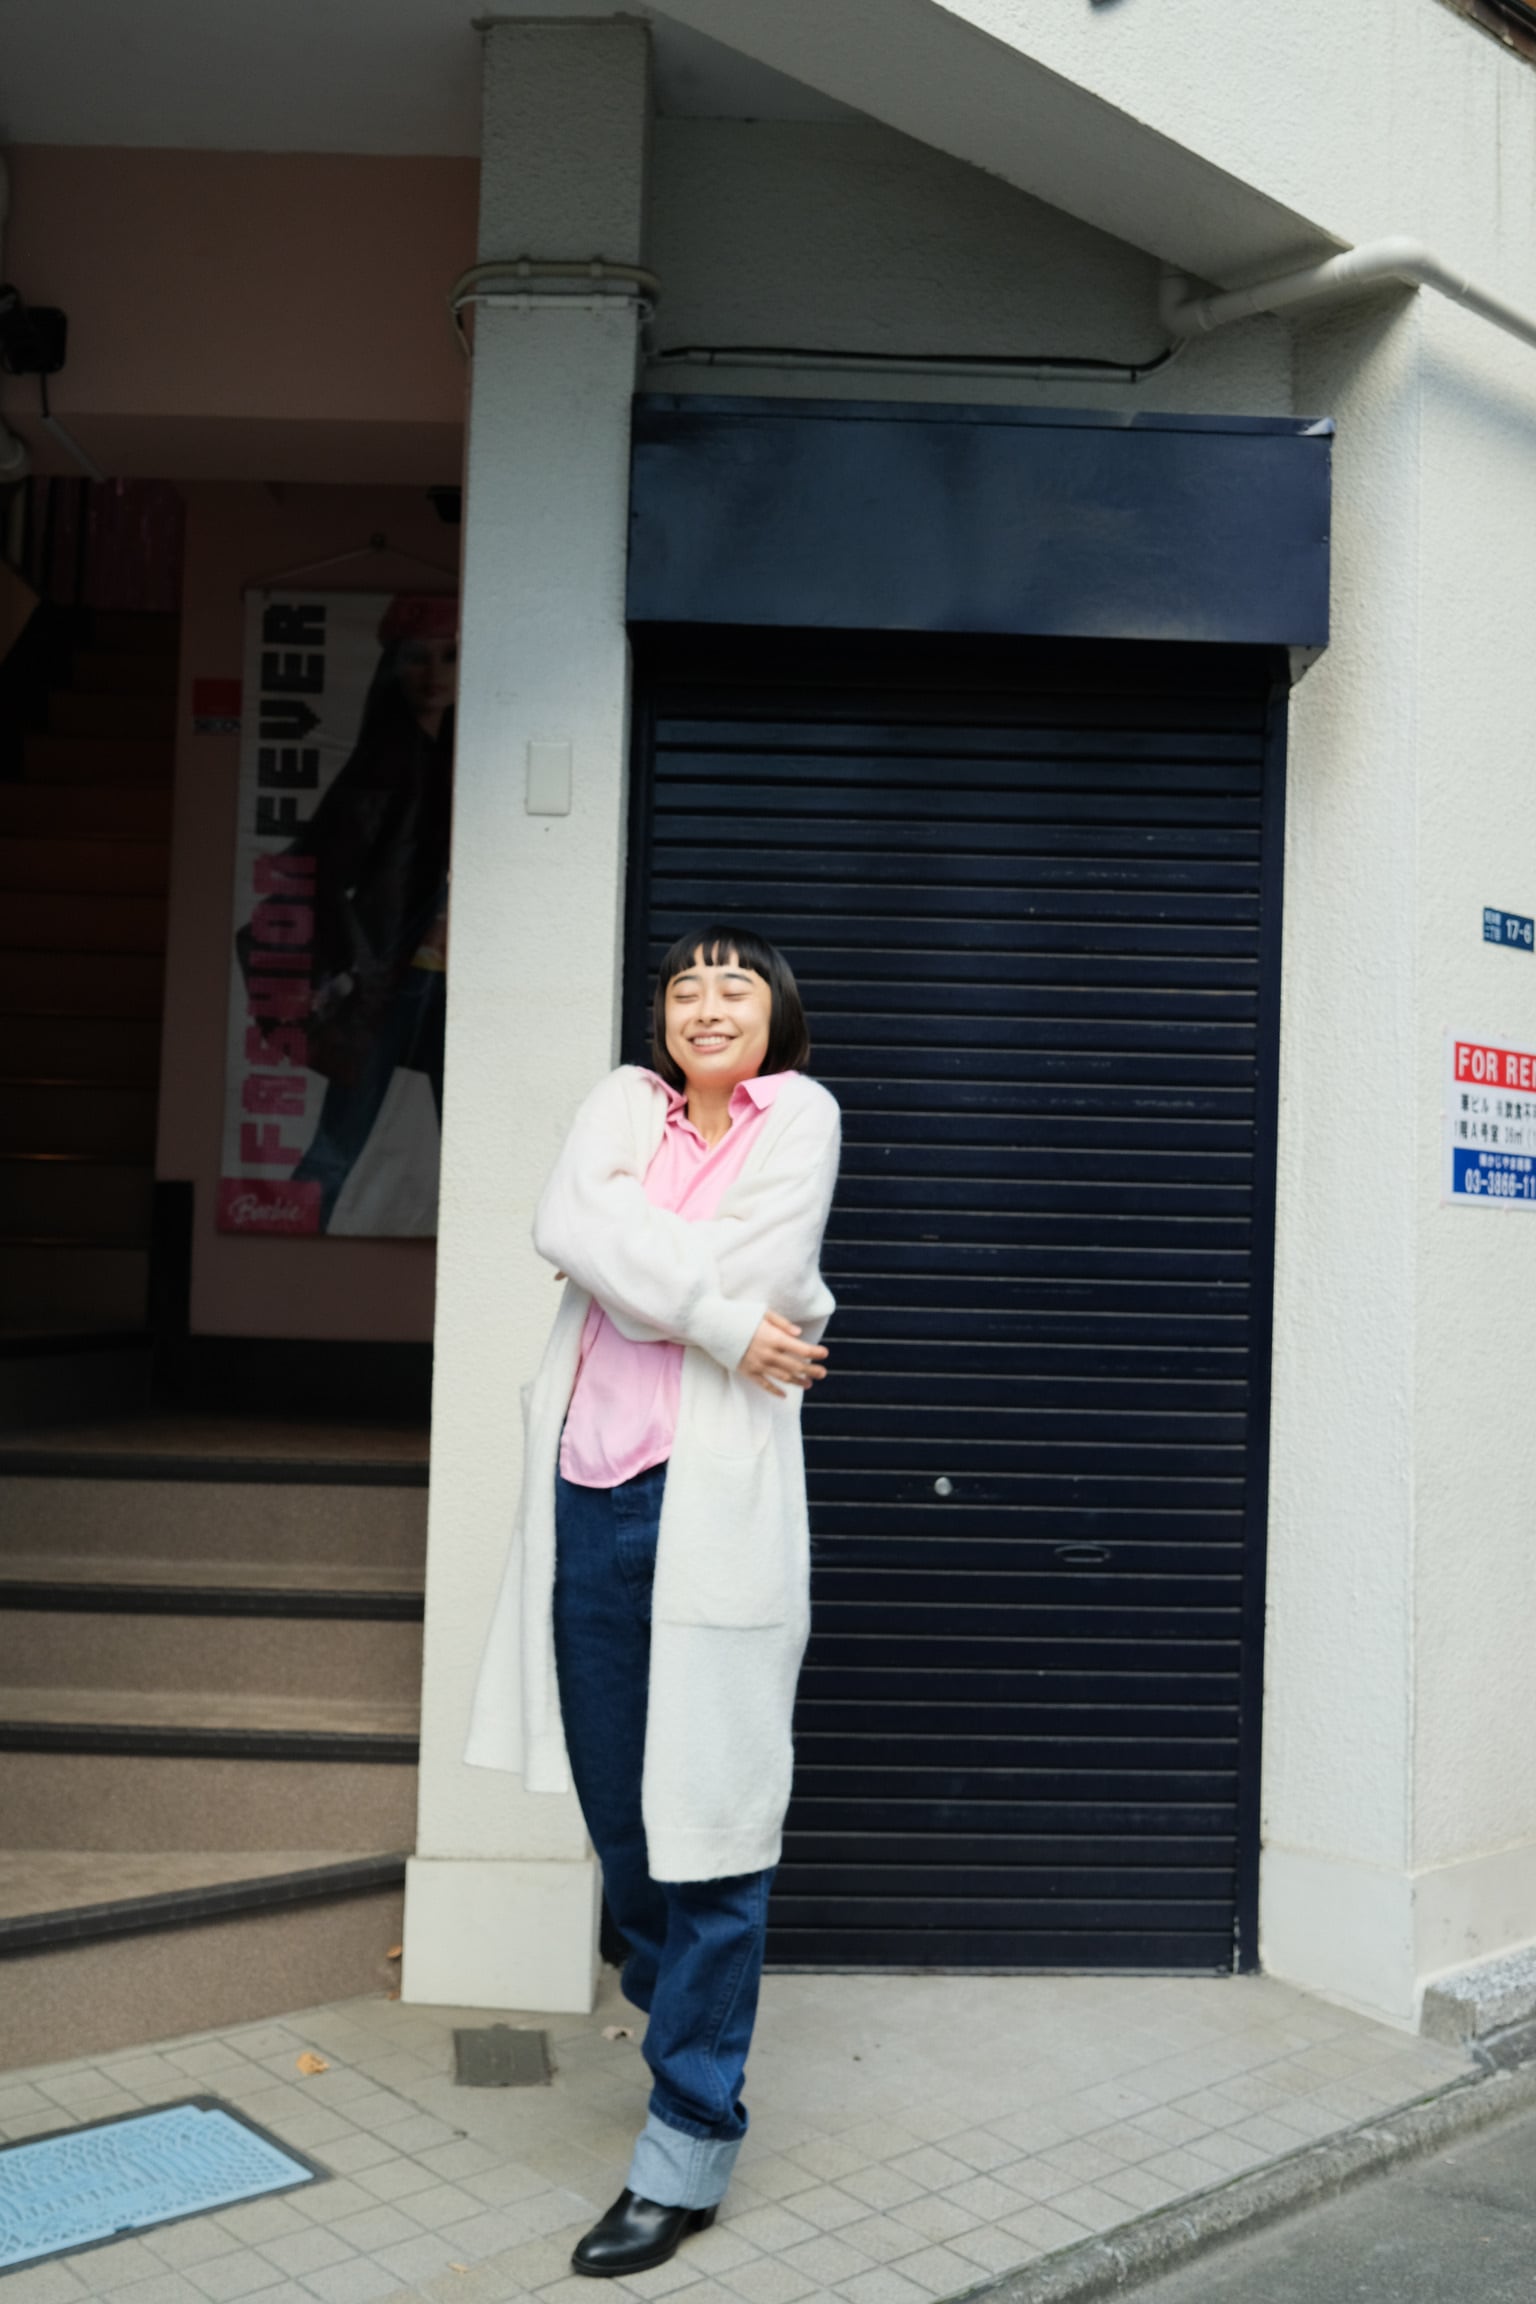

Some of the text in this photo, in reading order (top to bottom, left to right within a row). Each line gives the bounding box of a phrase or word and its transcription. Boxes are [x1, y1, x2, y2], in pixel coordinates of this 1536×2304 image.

[240, 603, 328, 1165] FASHION FEVER
[1506, 919, 1533, 944] 17-6
[1458, 1046, 1499, 1082] FOR
